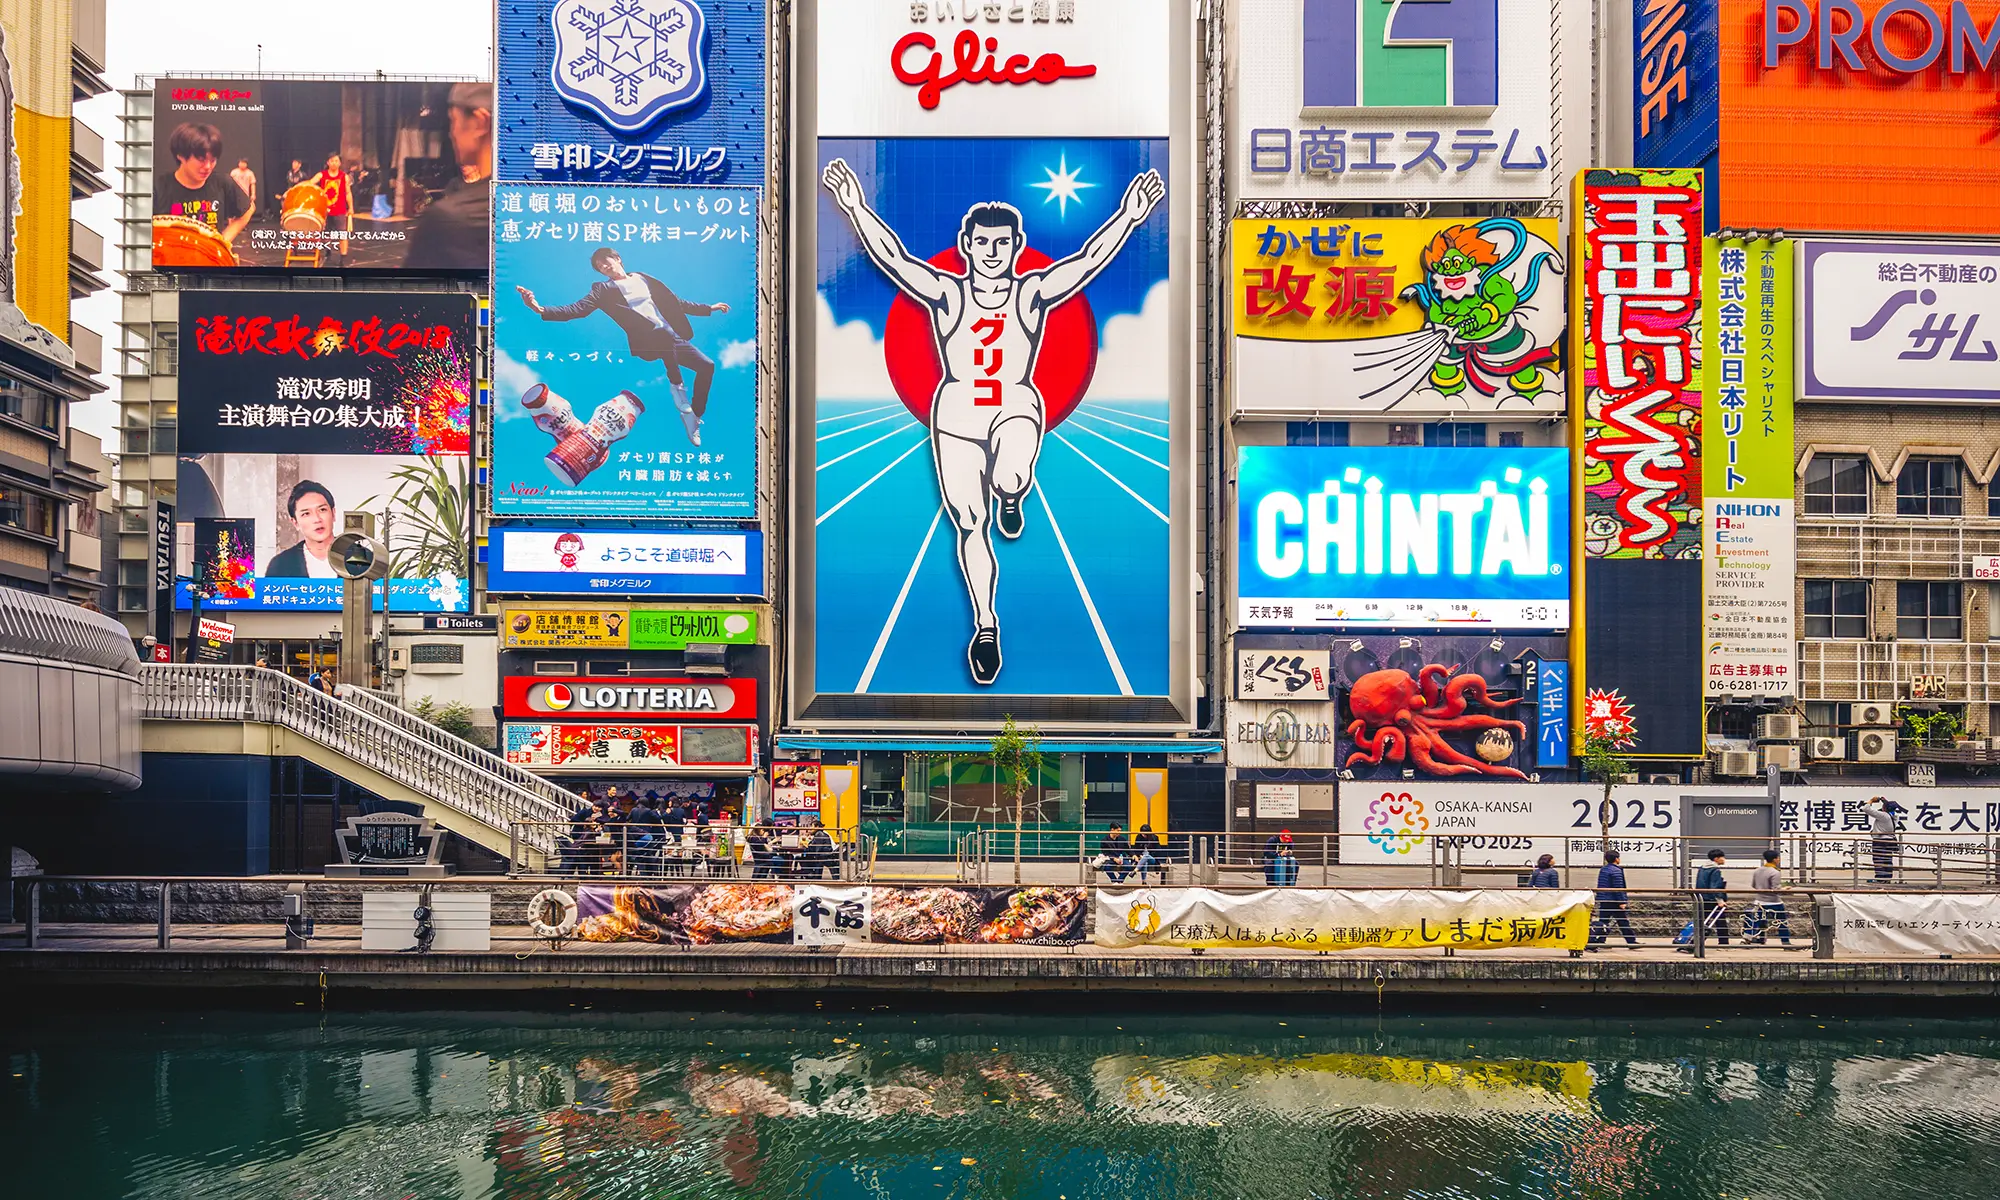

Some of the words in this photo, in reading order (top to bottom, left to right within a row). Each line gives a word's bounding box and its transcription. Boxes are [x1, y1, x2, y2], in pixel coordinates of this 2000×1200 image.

[909, 0, 1076, 23] おいしさと健康
[891, 30, 1097, 110] Glico
[196, 104, 219, 112] Blu-ray
[1250, 126, 1548, 174] 日商エステム
[530, 143, 727, 172] 雪印メグミルク
[501, 192, 751, 216] 道頓堀のおいしいものと
[280, 230, 406, 241] できるように練習してるんだから
[1257, 224, 1384, 259] かぜに
[251, 241, 294, 250] いいんだよ
[297, 240, 340, 250] 泣かなくて
[1878, 262, 1998, 284] 総合不動産の
[1243, 265, 1399, 321] 改源
[1760, 250, 1775, 438] 不動産再生のスペシャリスト
[525, 350, 625, 364] 軽々、つづく。
[970, 314, 1007, 406] グリコ
[1719, 248, 1746, 490] 株式会社日本リート
[276, 376, 372, 401] 滝沢秀明
[218, 404, 422, 428] 主演舞台の集大成！
[618, 451, 725, 465] ガセリ菌SP株が
[618, 469, 733, 483] 内臓脂肪を減らす
[500, 481, 549, 496] New!
[1716, 504, 1781, 517] NIHON
[1257, 467, 1549, 579] CHINTAI
[1716, 518, 1745, 529] Real
[1716, 531, 1754, 543] Estate
[157, 510, 170, 591] TSUTAYA
[600, 547, 733, 563] ようこそ道頓堀へ
[1716, 544, 1769, 556] Investment
[1714, 557, 1771, 570] Technology
[1715, 571, 1757, 580] SERVICE
[263, 585, 343, 594] メンバーセレクトに
[589, 578, 652, 588] 雪印メグミルク
[1715, 580, 1765, 589] PROVIDER
[262, 595, 344, 605] 長尺ドキュメントを
[1249, 605, 1294, 619] 天気予報
[201, 620, 233, 634] Welcome
[451, 619, 483, 628] Toilets
[536, 615, 599, 625] 店舗情報館
[670, 614, 720, 637] ピタットハウス
[207, 631, 232, 643] OSAKA
[157, 647, 168, 660] 本
[1255, 655, 1312, 692] くくる
[1526, 660, 1537, 691] 2F
[1709, 664, 1787, 677] 広告主募集中
[1709, 680, 1788, 691] 06-6281-1717
[1911, 675, 1946, 692] BAR
[579, 687, 716, 710] LOTTERIA
[1542, 669, 1563, 757] ペンギンバー
[596, 727, 643, 739] たこやき
[1305, 721, 1332, 745] BAR
[553, 726, 561, 764] TAKOYAKI
[1909, 764, 1934, 776] BAR
[805, 797, 816, 807] 8F
[1435, 801, 1532, 813] OSAKA-KANSAI
[1717, 807, 1758, 816] information
[1435, 816, 1476, 828] JAPAN
[1169, 924, 1318, 943] 医療法人はぁとふる
[1331, 927, 1414, 944] 運動器ケア
[1419, 915, 1567, 944] しまだ病院
